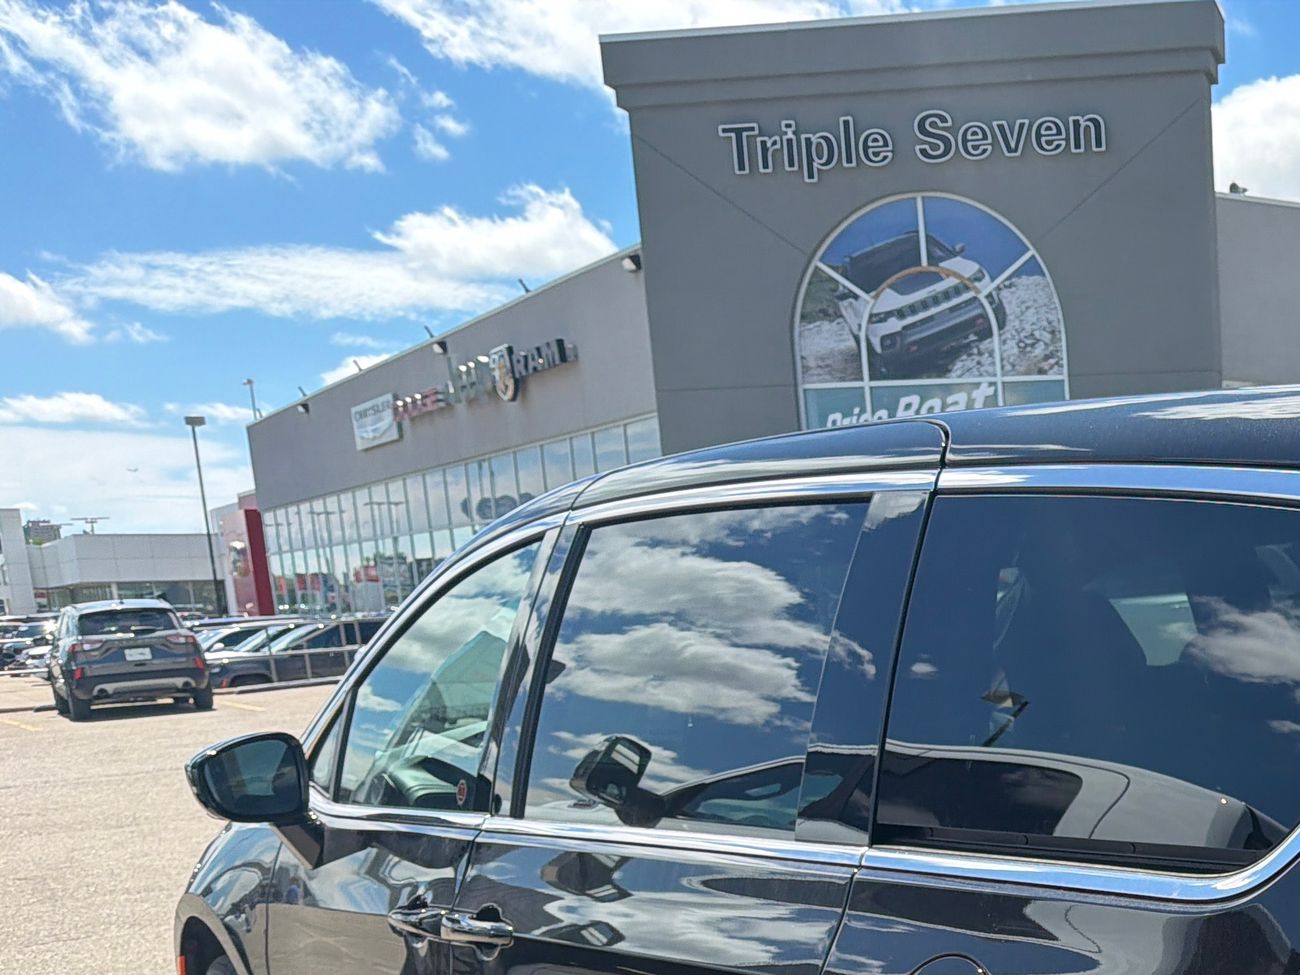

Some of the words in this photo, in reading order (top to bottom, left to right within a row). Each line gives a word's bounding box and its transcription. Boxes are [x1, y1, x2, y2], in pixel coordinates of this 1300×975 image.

[718, 116, 893, 183] Triple
[914, 109, 1107, 164] Seven
[512, 339, 568, 379] RAM
